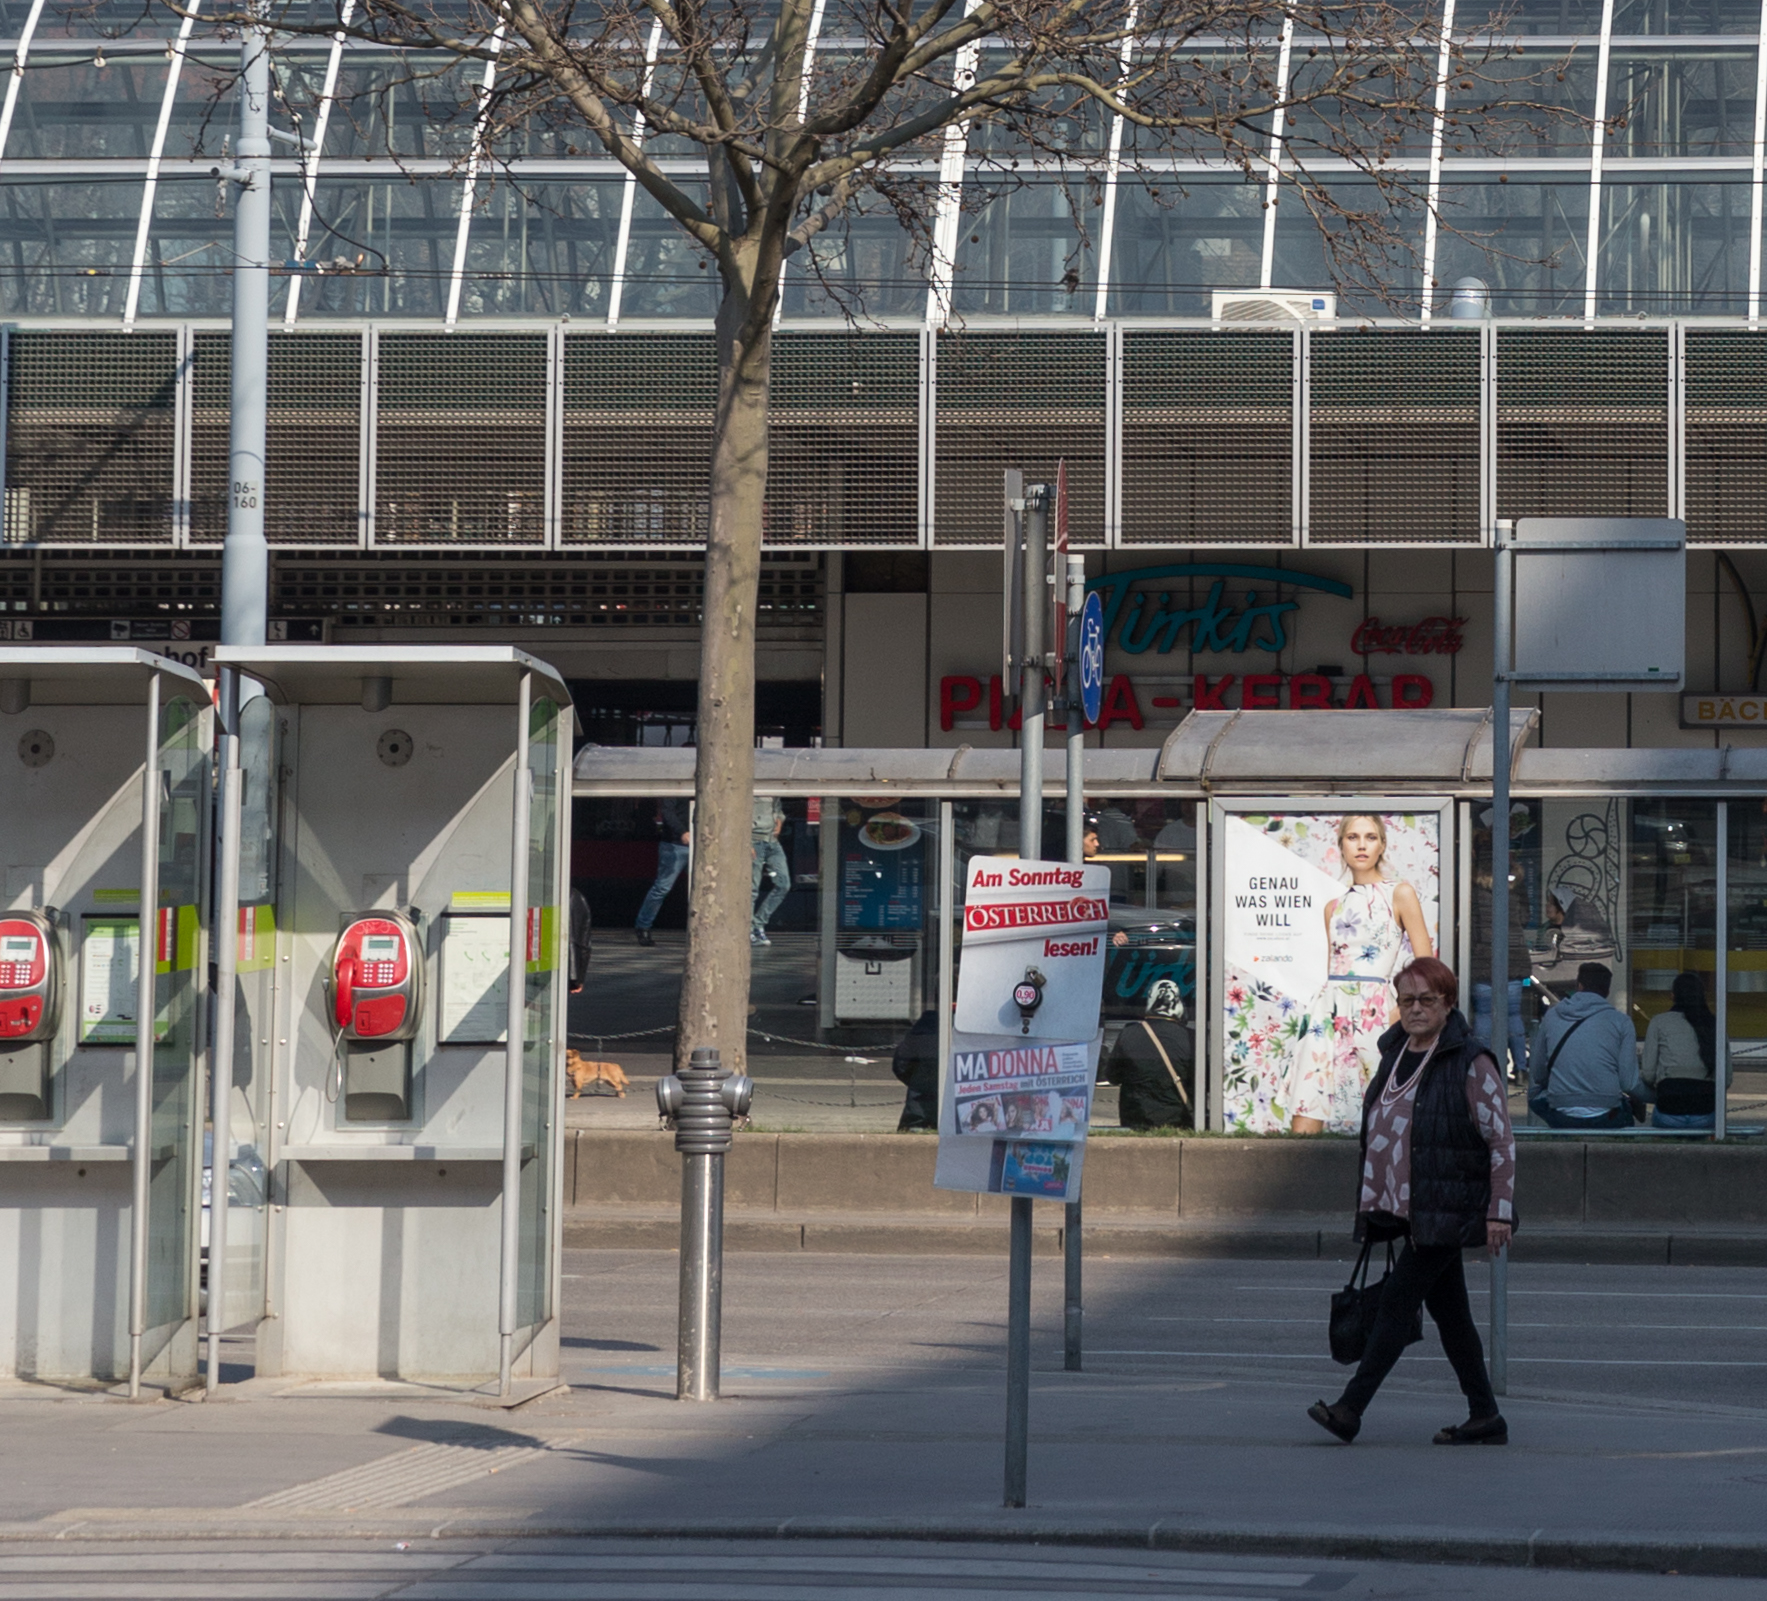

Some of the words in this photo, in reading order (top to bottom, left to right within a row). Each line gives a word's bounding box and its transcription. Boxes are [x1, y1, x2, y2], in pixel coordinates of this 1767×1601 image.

[233, 482, 257, 494] 06-
[233, 497, 257, 509] 160
[1088, 563, 1353, 655] Türkis
[972, 870, 1003, 888] Am
[1008, 867, 1085, 889] Sonntag
[1249, 877, 1299, 890] GENAU
[1235, 895, 1267, 908] WAS
[1274, 895, 1312, 908] WIEN
[968, 901, 1106, 928] ÖSTERREICH
[1256, 914, 1291, 927] WILL
[1044, 937, 1099, 957] lesen!
[1261, 955, 1293, 963] zalando
[956, 1047, 1060, 1082] MADONNA
[958, 1083, 982, 1095] Jeden
[983, 1080, 1019, 1093] Samstag
[1020, 1079, 1034, 1089] mit
[1035, 1074, 1086, 1088] ÖSTERREICH
